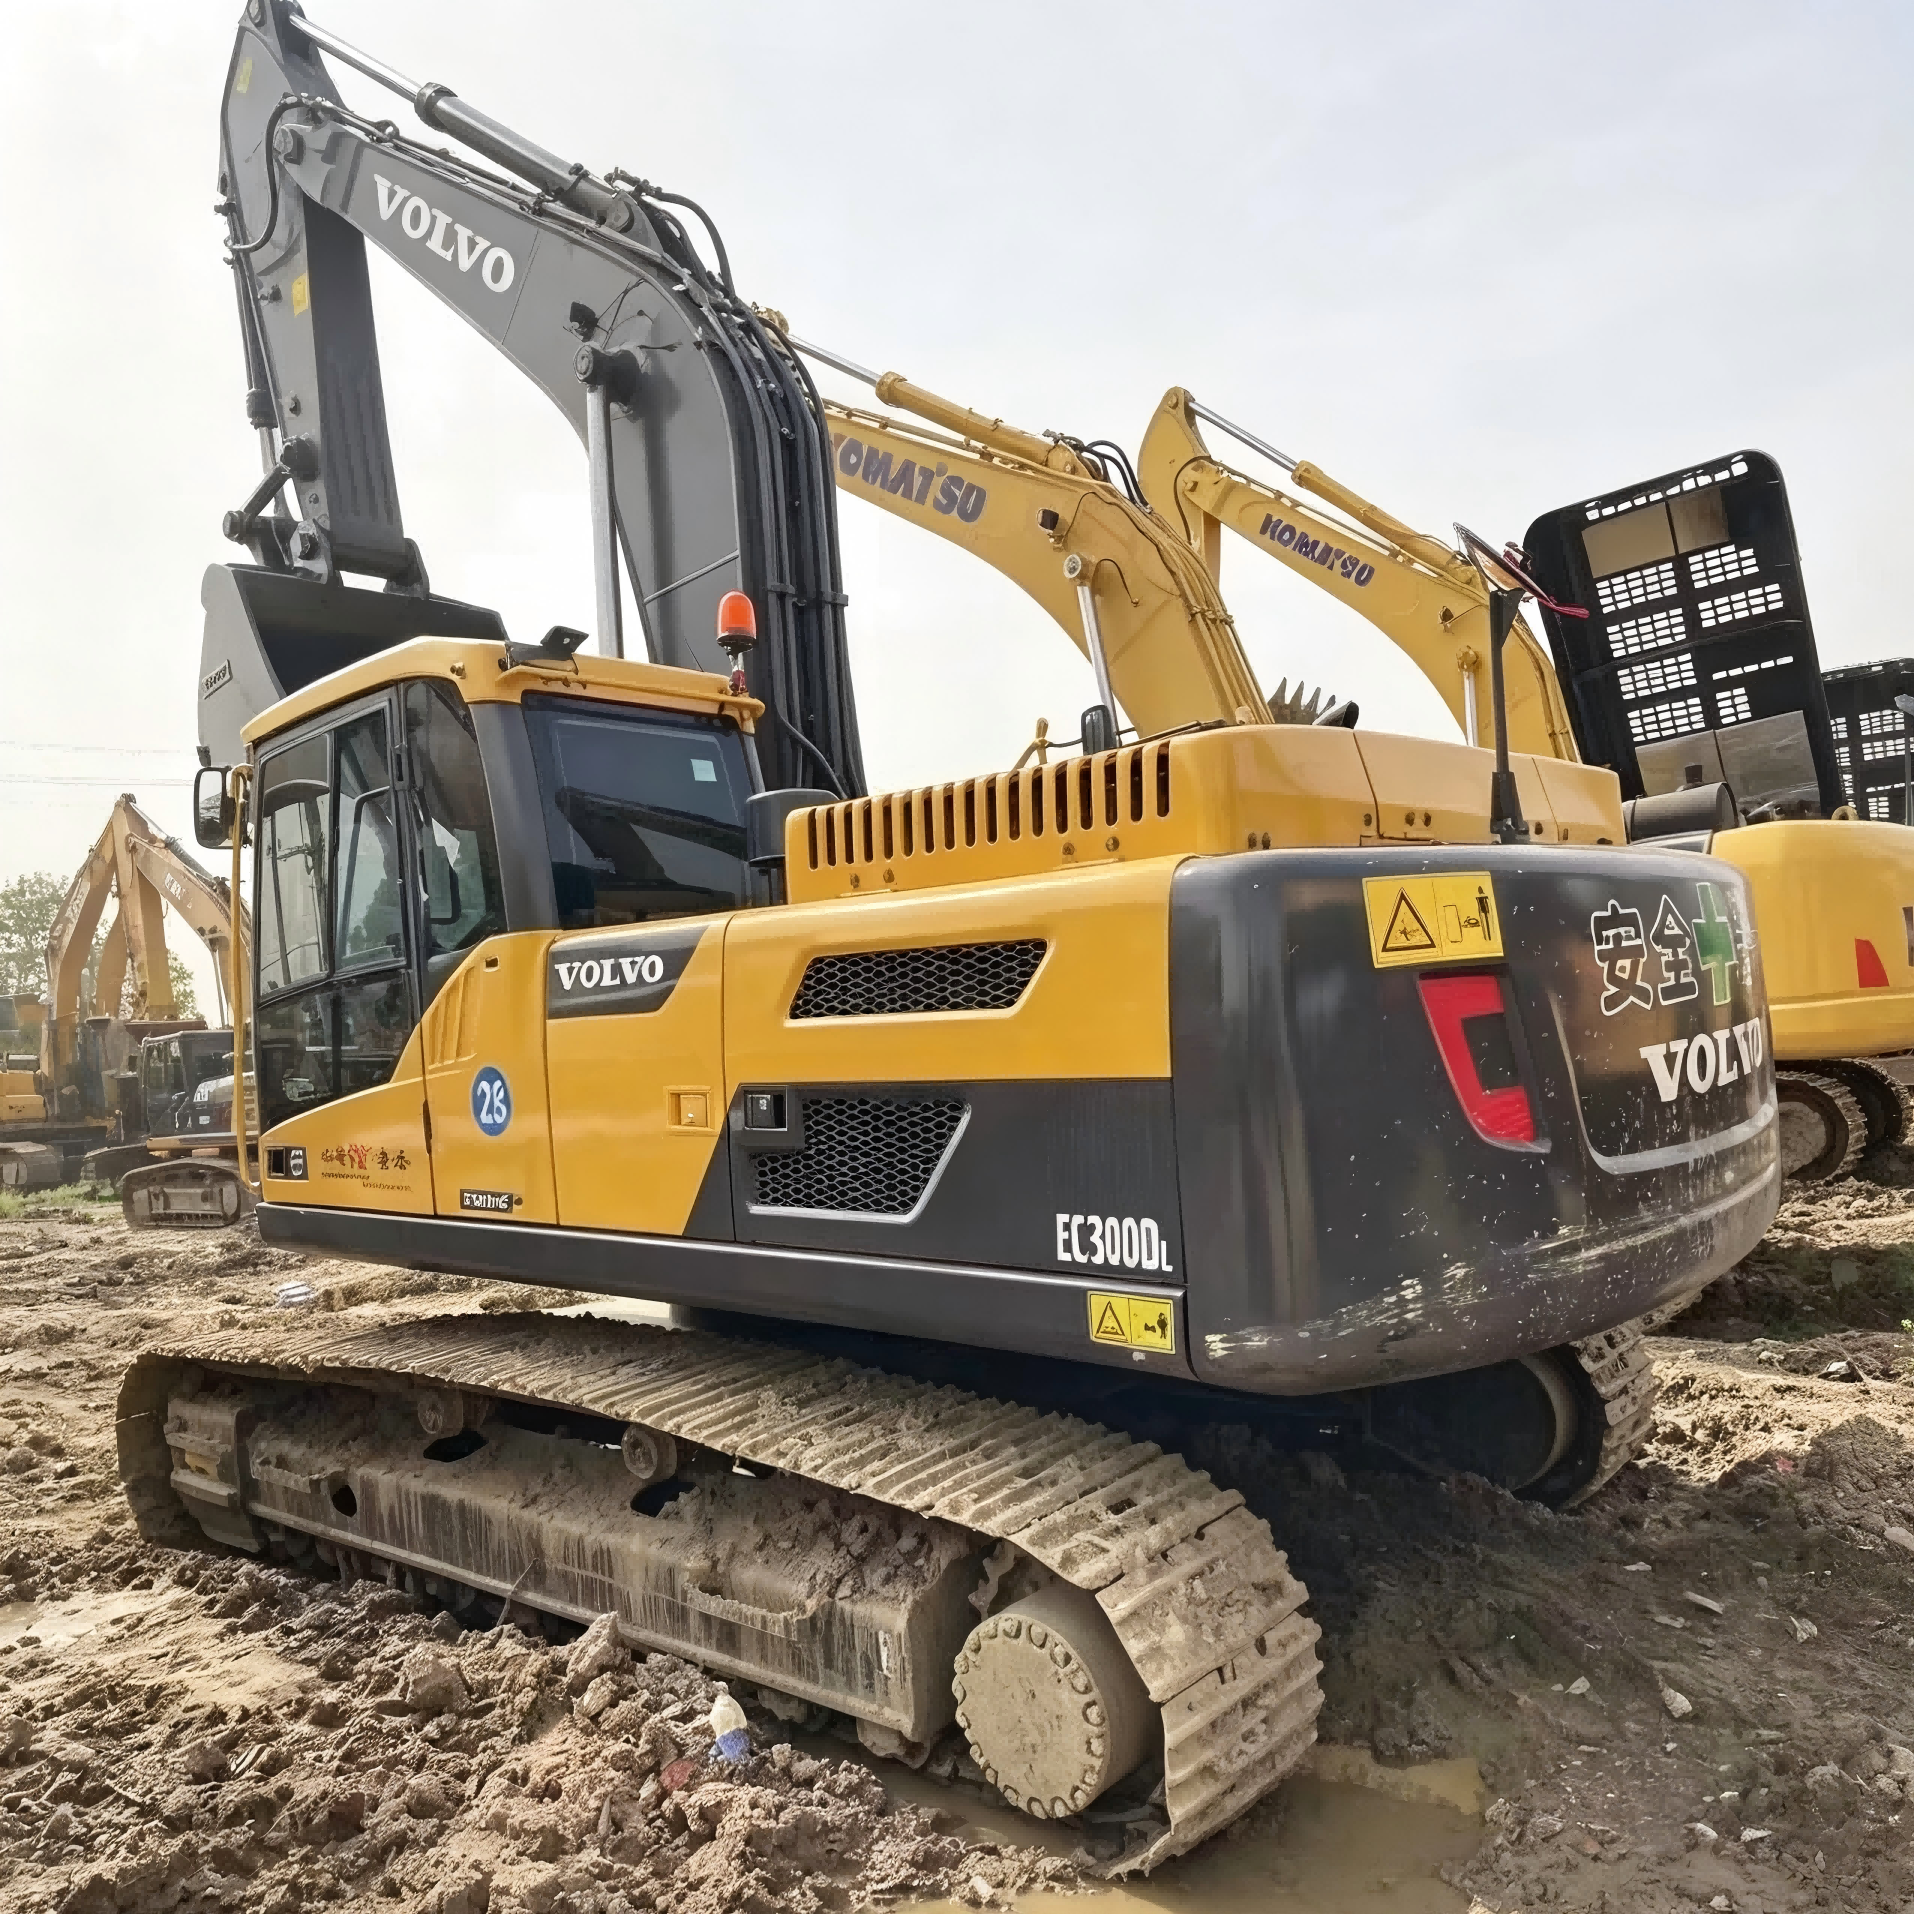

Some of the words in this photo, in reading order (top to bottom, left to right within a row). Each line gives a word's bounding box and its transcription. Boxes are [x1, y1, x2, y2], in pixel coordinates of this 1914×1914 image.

[373, 173, 515, 293] VOLVO
[1259, 512, 1376, 588] KOMATSU
[554, 954, 664, 991] VOLVO
[1639, 1016, 1763, 1103] VOLVO
